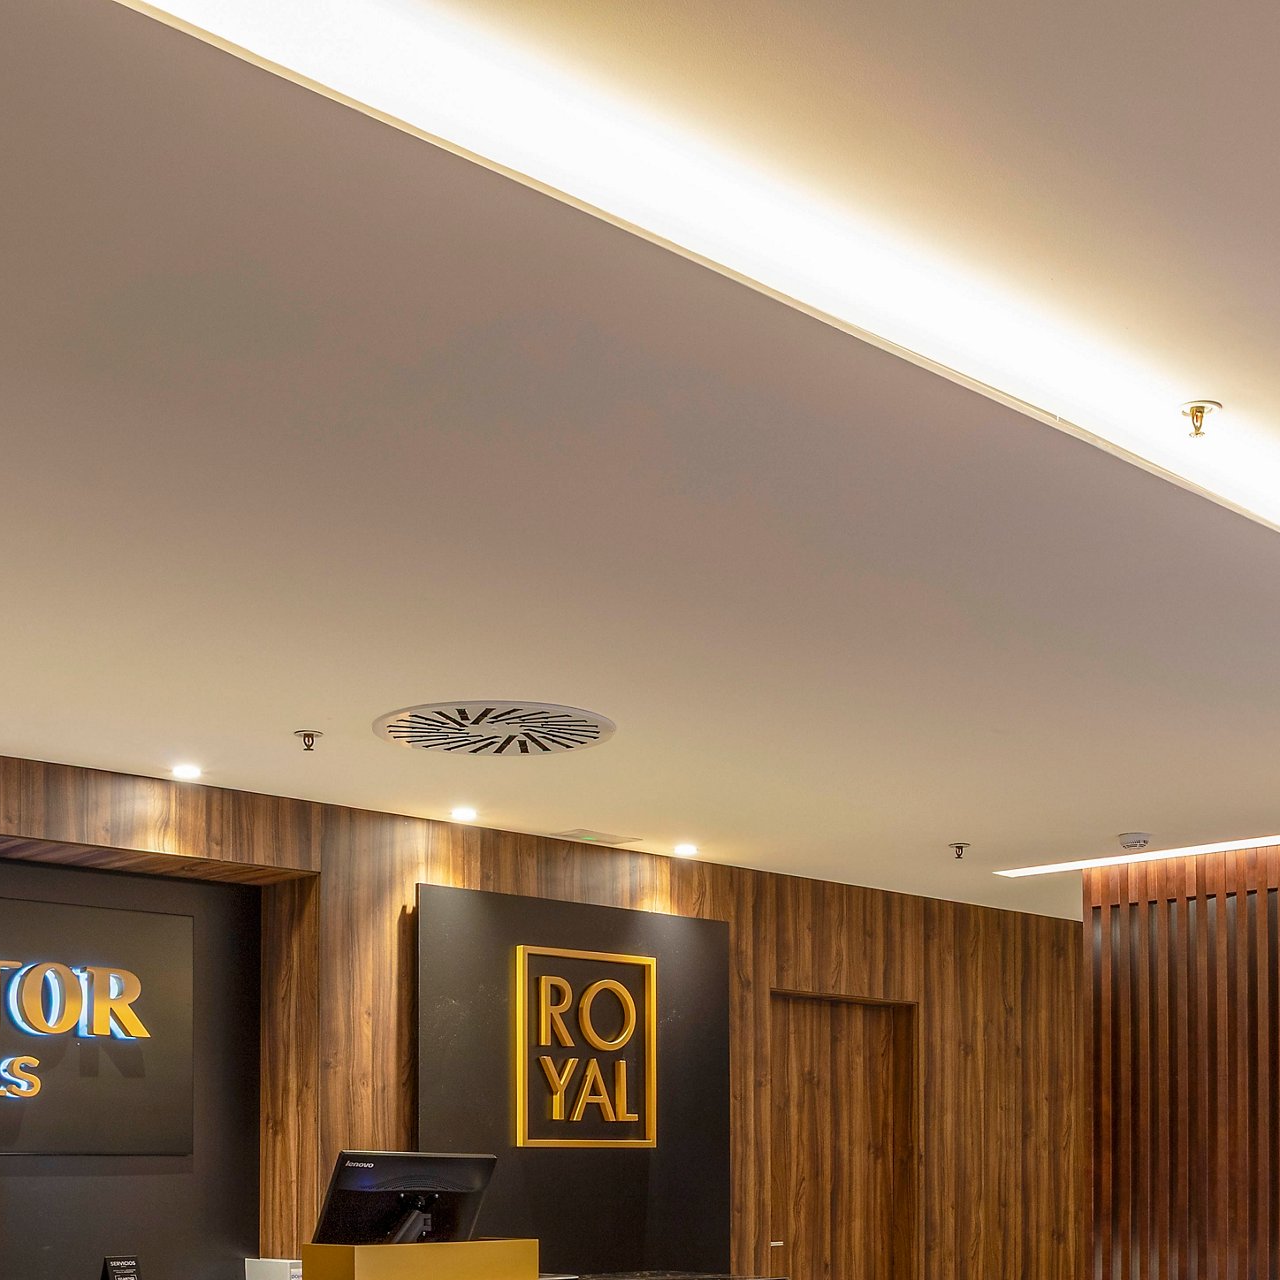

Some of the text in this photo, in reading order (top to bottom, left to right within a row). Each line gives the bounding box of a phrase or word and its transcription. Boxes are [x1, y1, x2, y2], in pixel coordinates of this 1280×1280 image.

[539, 976, 636, 1051] RO
[539, 1056, 639, 1121] YAL
[345, 1160, 374, 1168] lenovo
